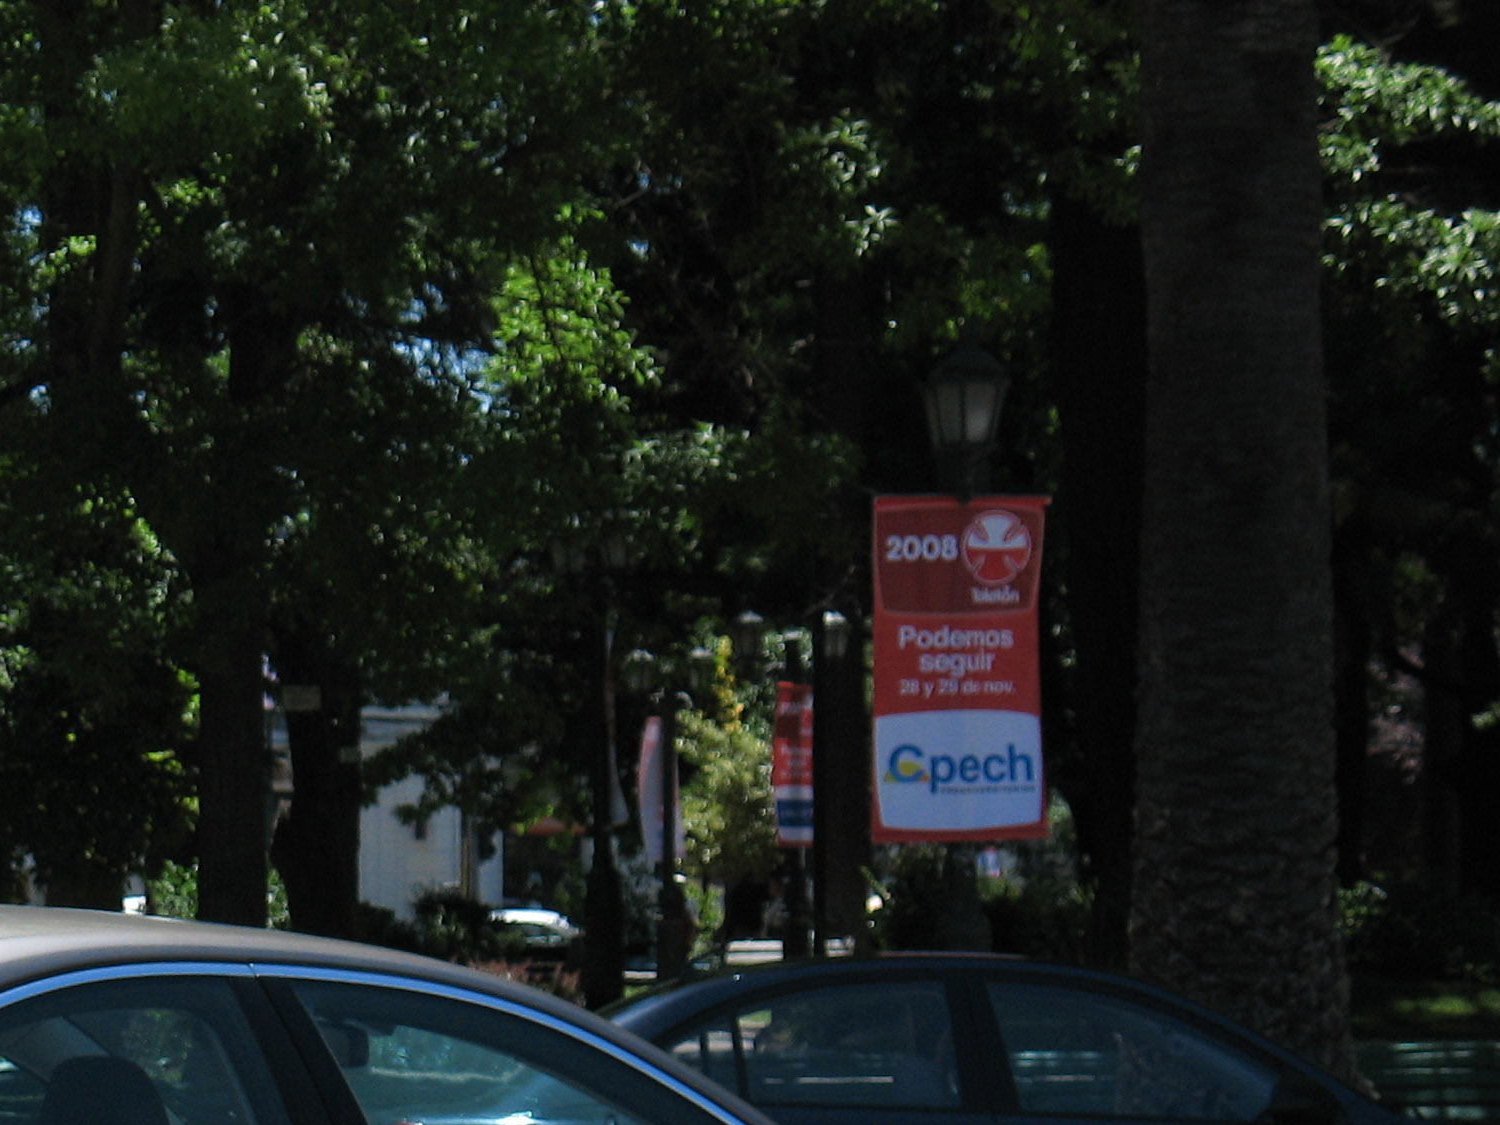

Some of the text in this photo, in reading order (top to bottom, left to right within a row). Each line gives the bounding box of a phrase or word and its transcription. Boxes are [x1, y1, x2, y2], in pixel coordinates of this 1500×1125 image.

[885, 534, 959, 561] 2008
[898, 624, 1014, 649] Podemos
[919, 649, 996, 677] seguir
[923, 681, 935, 699] y
[962, 678, 981, 695] de
[886, 742, 1036, 795] Cpech
